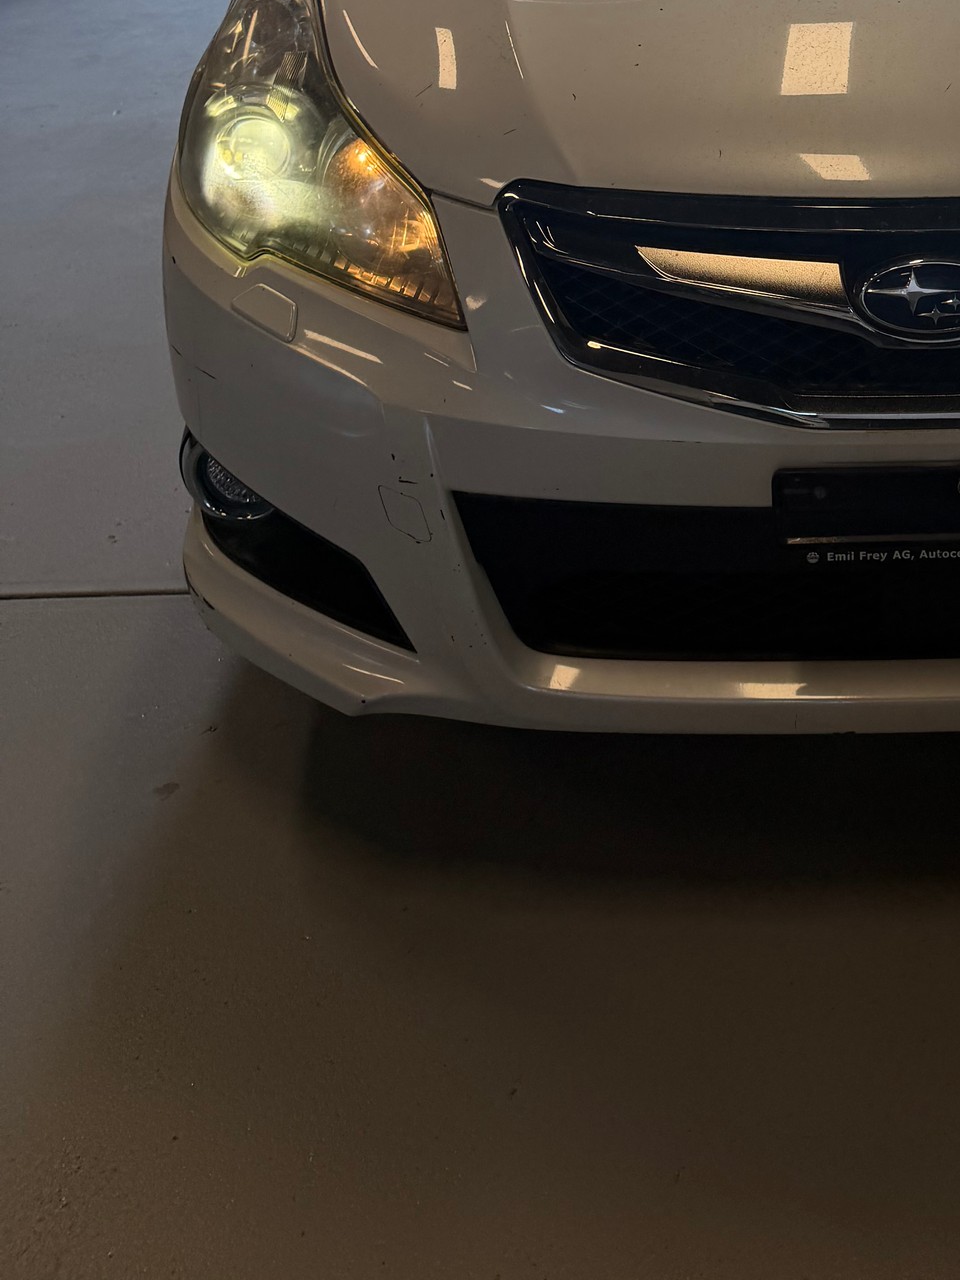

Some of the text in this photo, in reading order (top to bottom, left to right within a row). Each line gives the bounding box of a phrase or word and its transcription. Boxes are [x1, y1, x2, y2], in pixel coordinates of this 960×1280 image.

[827, 551, 855, 562] Emil
[859, 551, 888, 563] Frey
[892, 549, 915, 561] AG,
